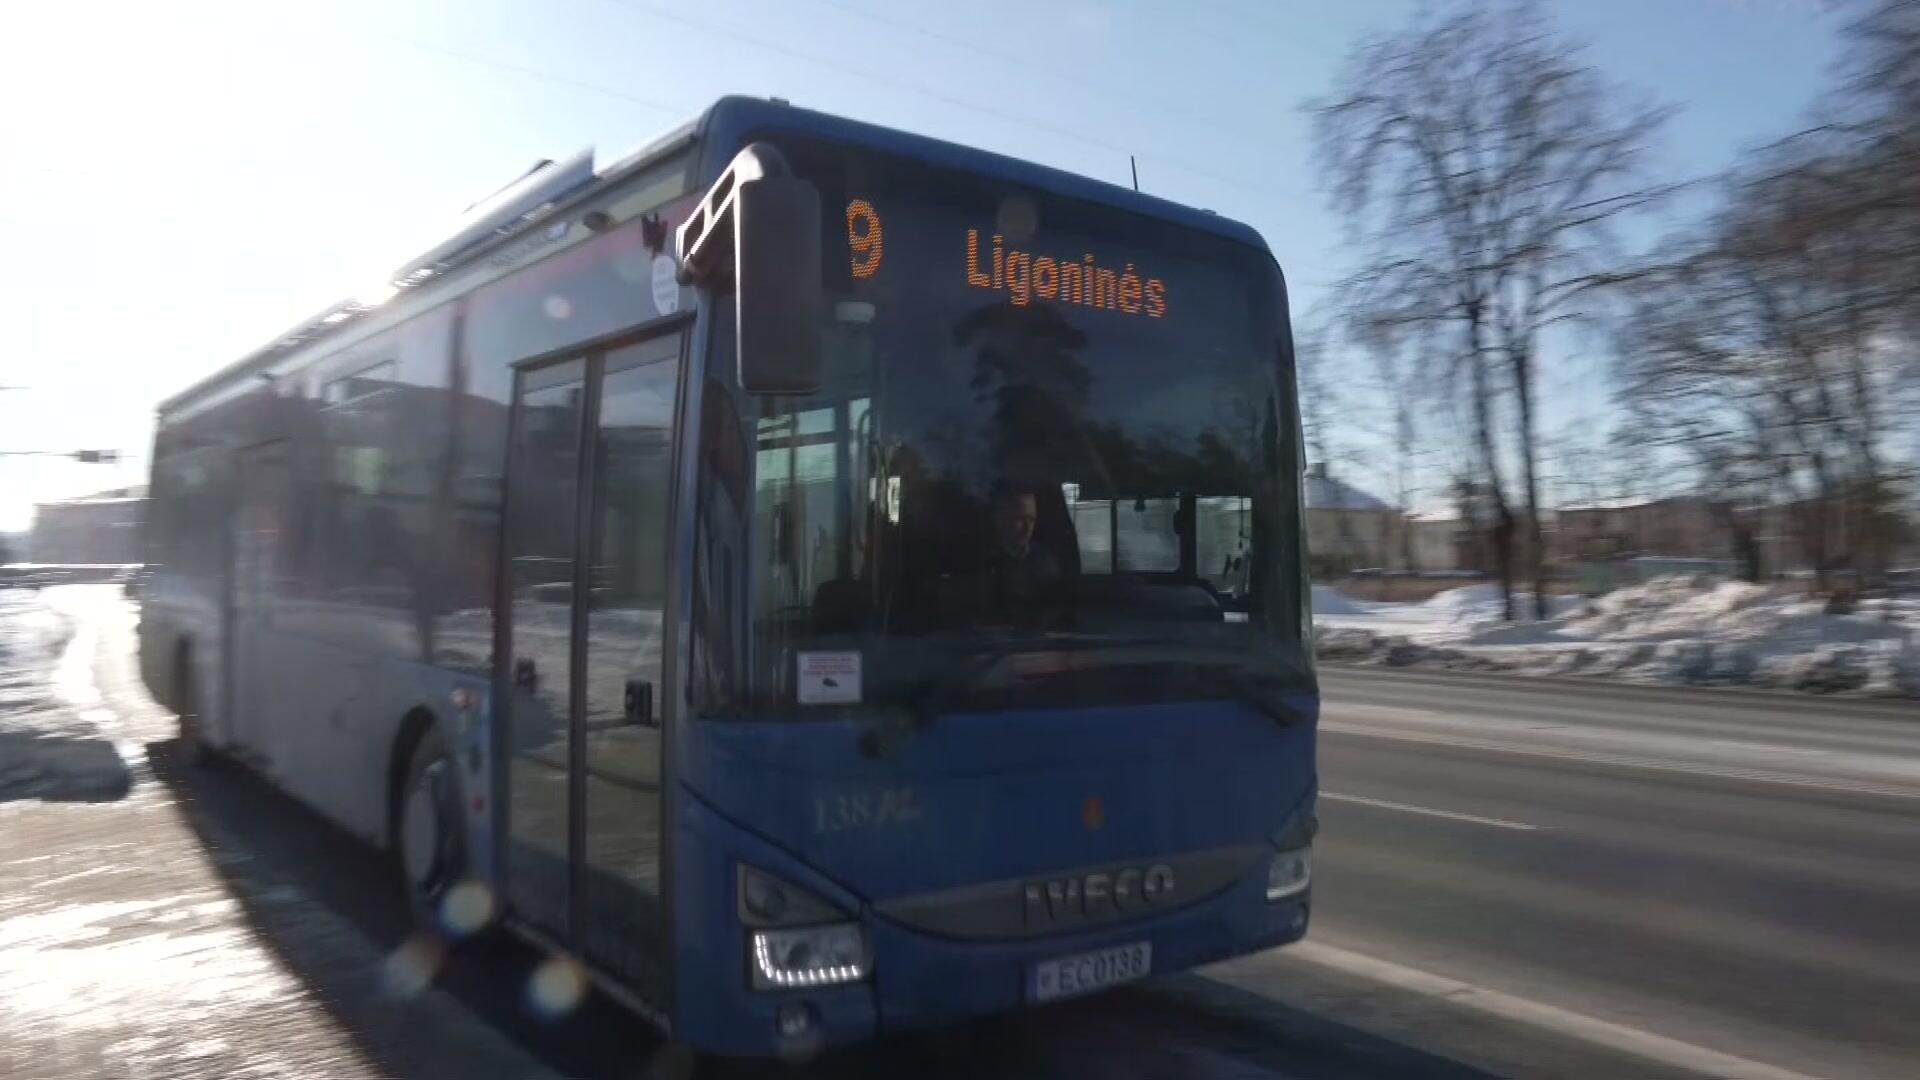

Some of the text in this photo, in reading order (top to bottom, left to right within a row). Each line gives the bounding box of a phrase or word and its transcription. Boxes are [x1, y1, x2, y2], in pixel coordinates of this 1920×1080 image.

[846, 199, 1166, 317] 9 Ligoninės
[1023, 864, 1175, 924] IVECO
